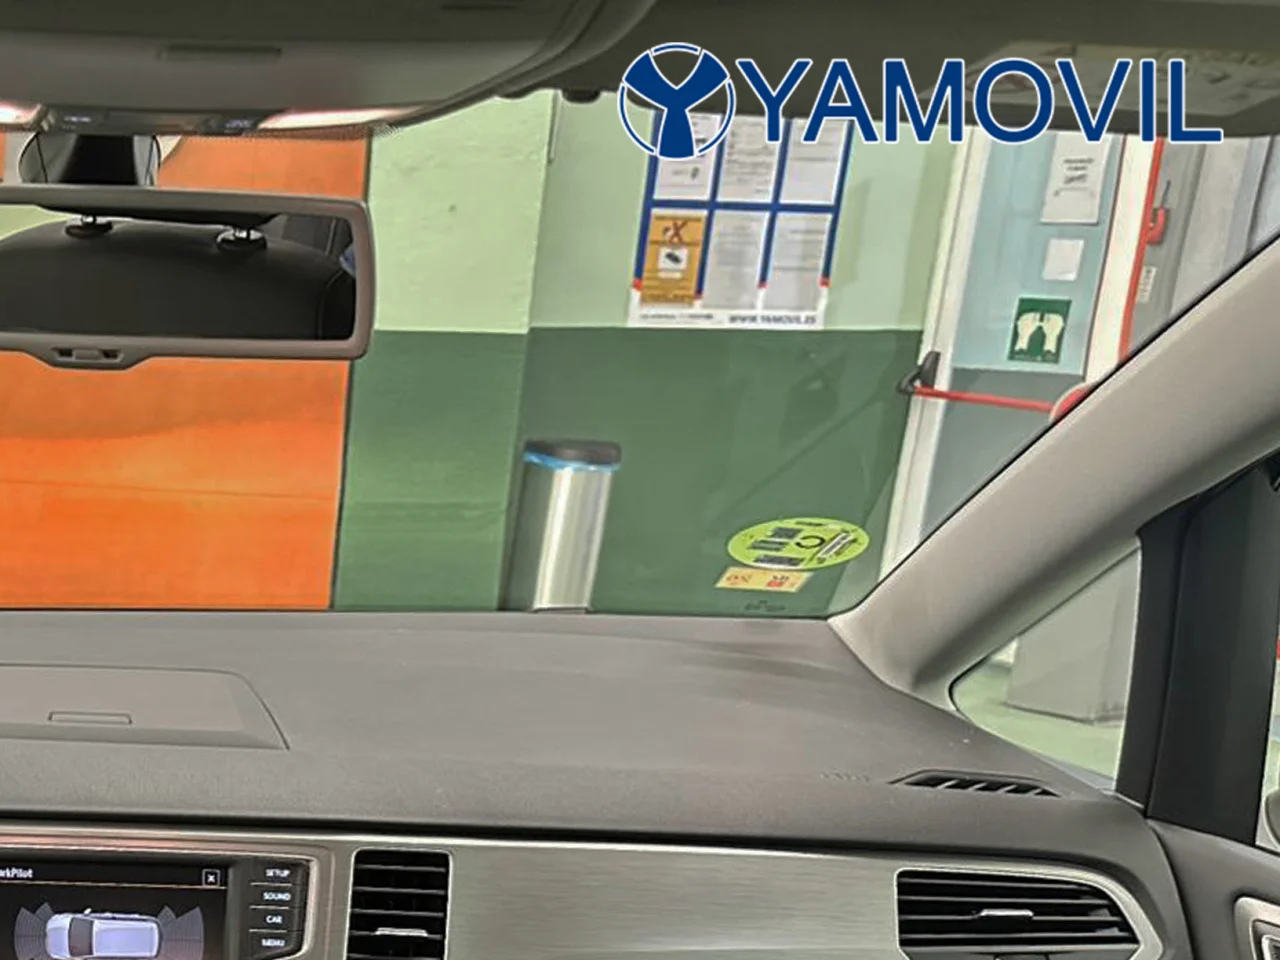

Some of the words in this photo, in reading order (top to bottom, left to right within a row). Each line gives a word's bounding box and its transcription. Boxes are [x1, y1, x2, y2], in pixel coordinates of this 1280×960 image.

[265, 868, 291, 877] SETUP
[263, 891, 292, 901] SOUND
[265, 915, 283, 924] CAR
[261, 938, 286, 947] MENU
